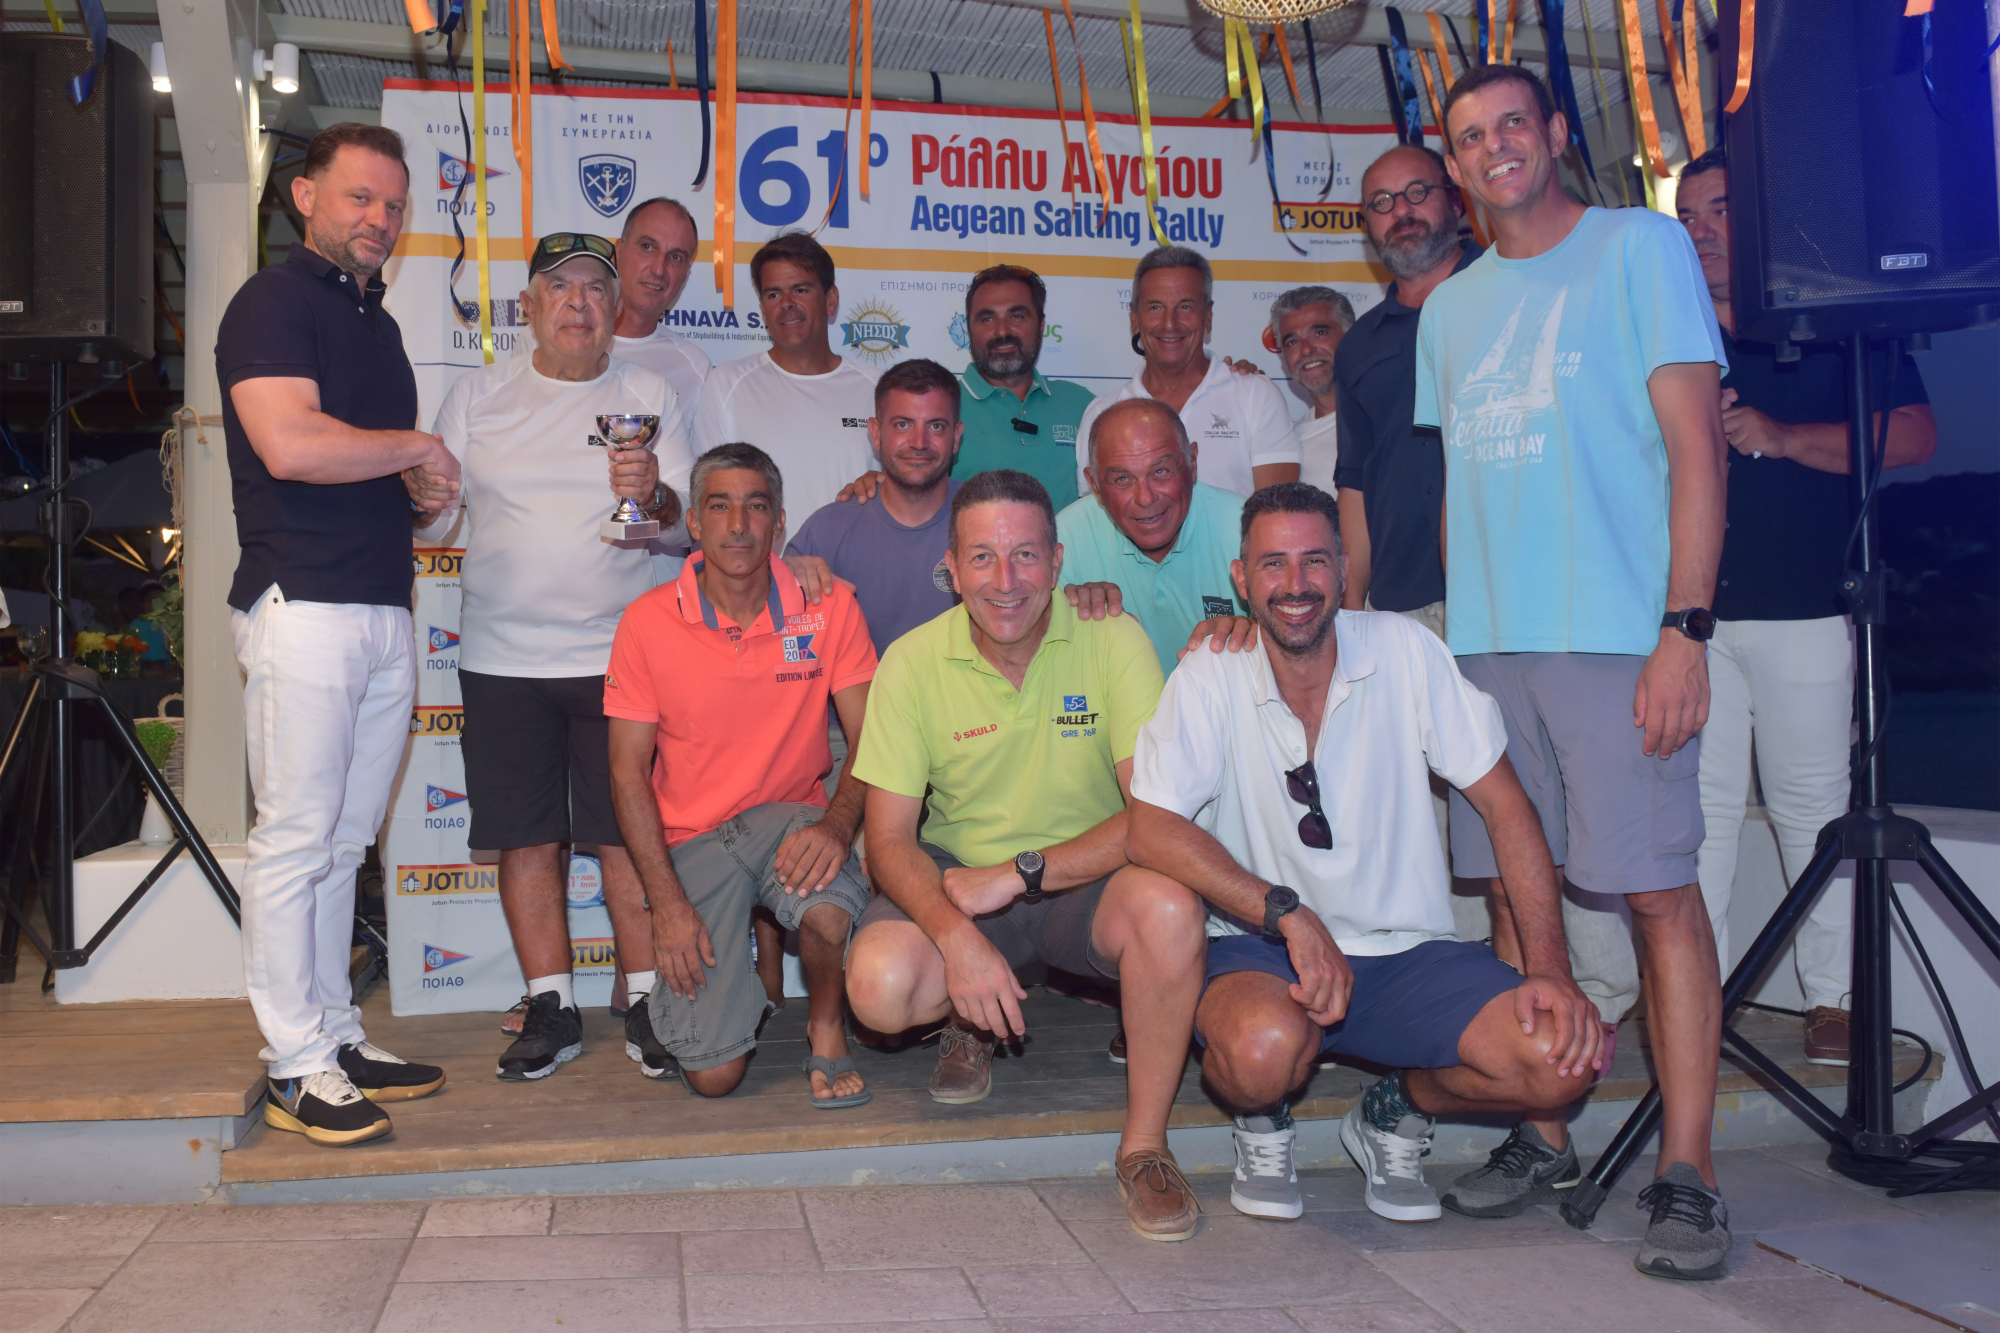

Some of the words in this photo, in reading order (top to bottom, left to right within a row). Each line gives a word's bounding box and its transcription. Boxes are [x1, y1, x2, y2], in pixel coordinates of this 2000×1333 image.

[580, 113, 598, 123] ΜΕ
[607, 114, 634, 124] ΤΗΝ
[426, 123, 510, 136] ΔΙΟΡΝΩΣ
[562, 127, 652, 140] ΣΥΝΕΡΓΑΣΙΑ
[1295, 175, 1351, 186] ΧΟΡΗΟΣ
[910, 195, 1026, 239] Aegean
[1033, 200, 1141, 246] Sailing
[1149, 205, 1224, 248] Rally
[1885, 255, 1923, 268] FBT
[880, 281, 937, 292] ΕΠΙΣΗΜΟΙ
[0, 302, 20, 311] BT
[659, 309, 740, 328] HNAVA
[747, 311, 769, 329] S.
[453, 330, 465, 349] D.
[692, 331, 725, 341] Shipbuilding
[731, 333, 757, 341] Industrial
[852, 323, 898, 343] ΝΗΣΟΣ
[1519, 433, 1546, 457] BAY
[814, 611, 825, 622] DE
[785, 649, 809, 661] 2017
[427, 659, 460, 670] ΠΟΙΑ
[776, 672, 803, 683] EDITION
[1056, 712, 1099, 725] BULLET
[963, 723, 998, 739] SKULD
[1061, 729, 1079, 738] GRE
[425, 817, 466, 829] ΠΟΙΑΘ
[423, 870, 496, 892] JOTUN
[422, 976, 464, 989] ΠΟΙΑΘ
